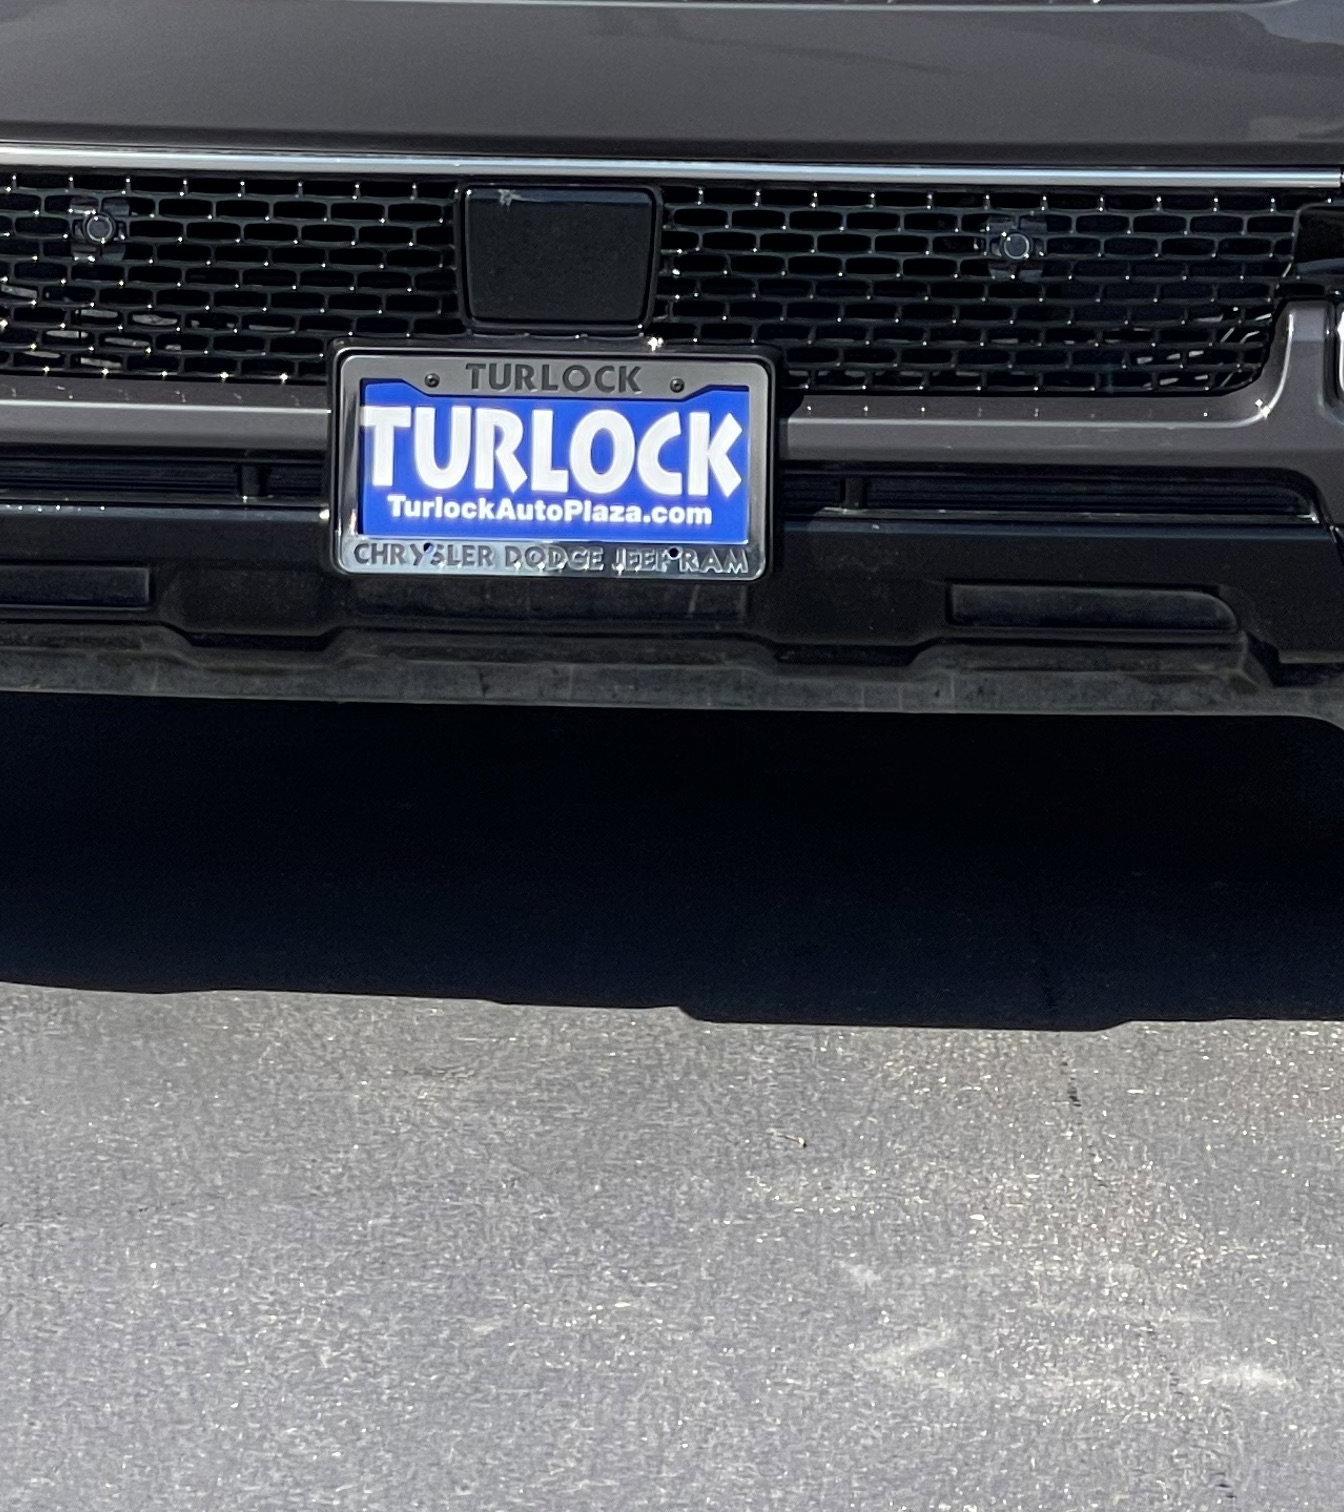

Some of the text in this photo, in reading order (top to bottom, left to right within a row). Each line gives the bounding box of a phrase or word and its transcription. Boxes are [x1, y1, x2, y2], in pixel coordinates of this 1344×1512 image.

[465, 362, 642, 393] TURLOCK
[361, 404, 742, 497] TURLOCK
[387, 495, 712, 524] TurlockAutoPlaza.com
[353, 543, 495, 568] CHRYSLER
[505, 545, 604, 572] DODGE
[674, 549, 749, 574] RAM
